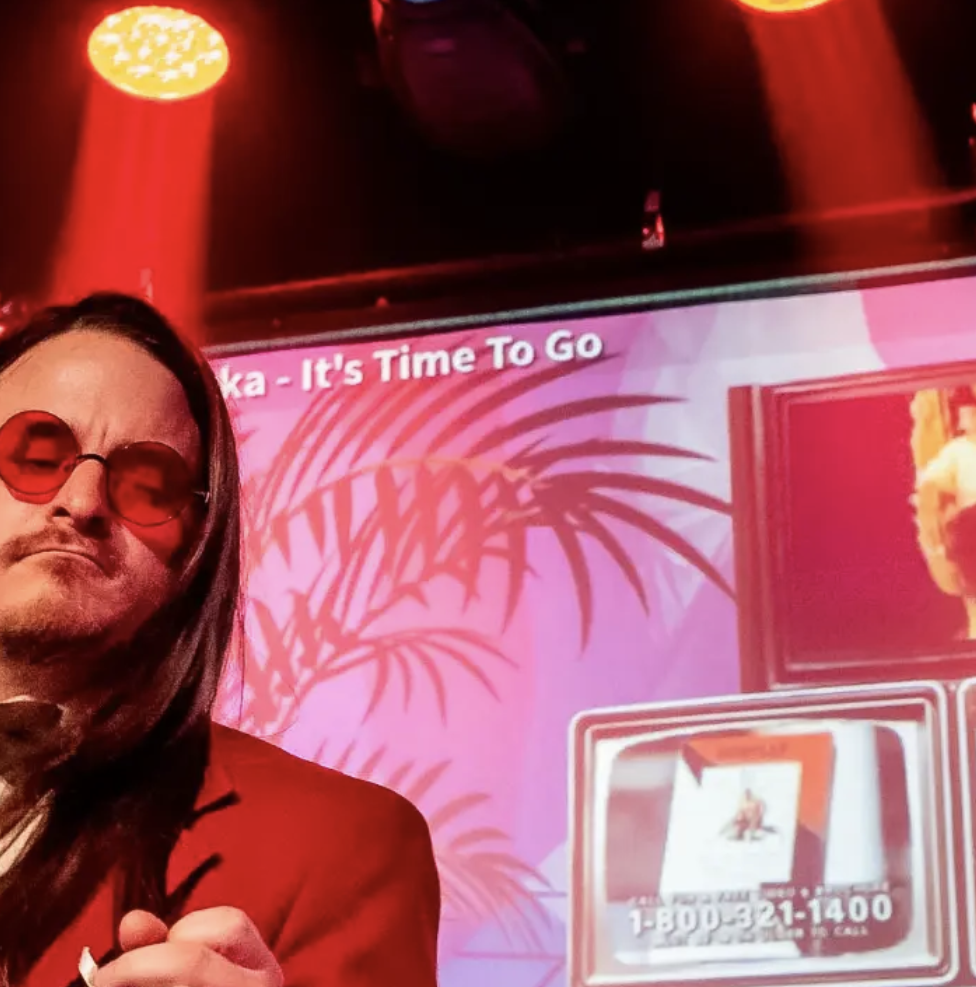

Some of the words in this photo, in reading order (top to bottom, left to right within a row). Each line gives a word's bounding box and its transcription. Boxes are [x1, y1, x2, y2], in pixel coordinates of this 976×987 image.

[301, 352, 364, 392] It's
[373, 344, 476, 382] Time
[484, 335, 535, 370] To
[545, 329, 603, 362] Go
[628, 894, 893, 938] 1-800-321-1400
